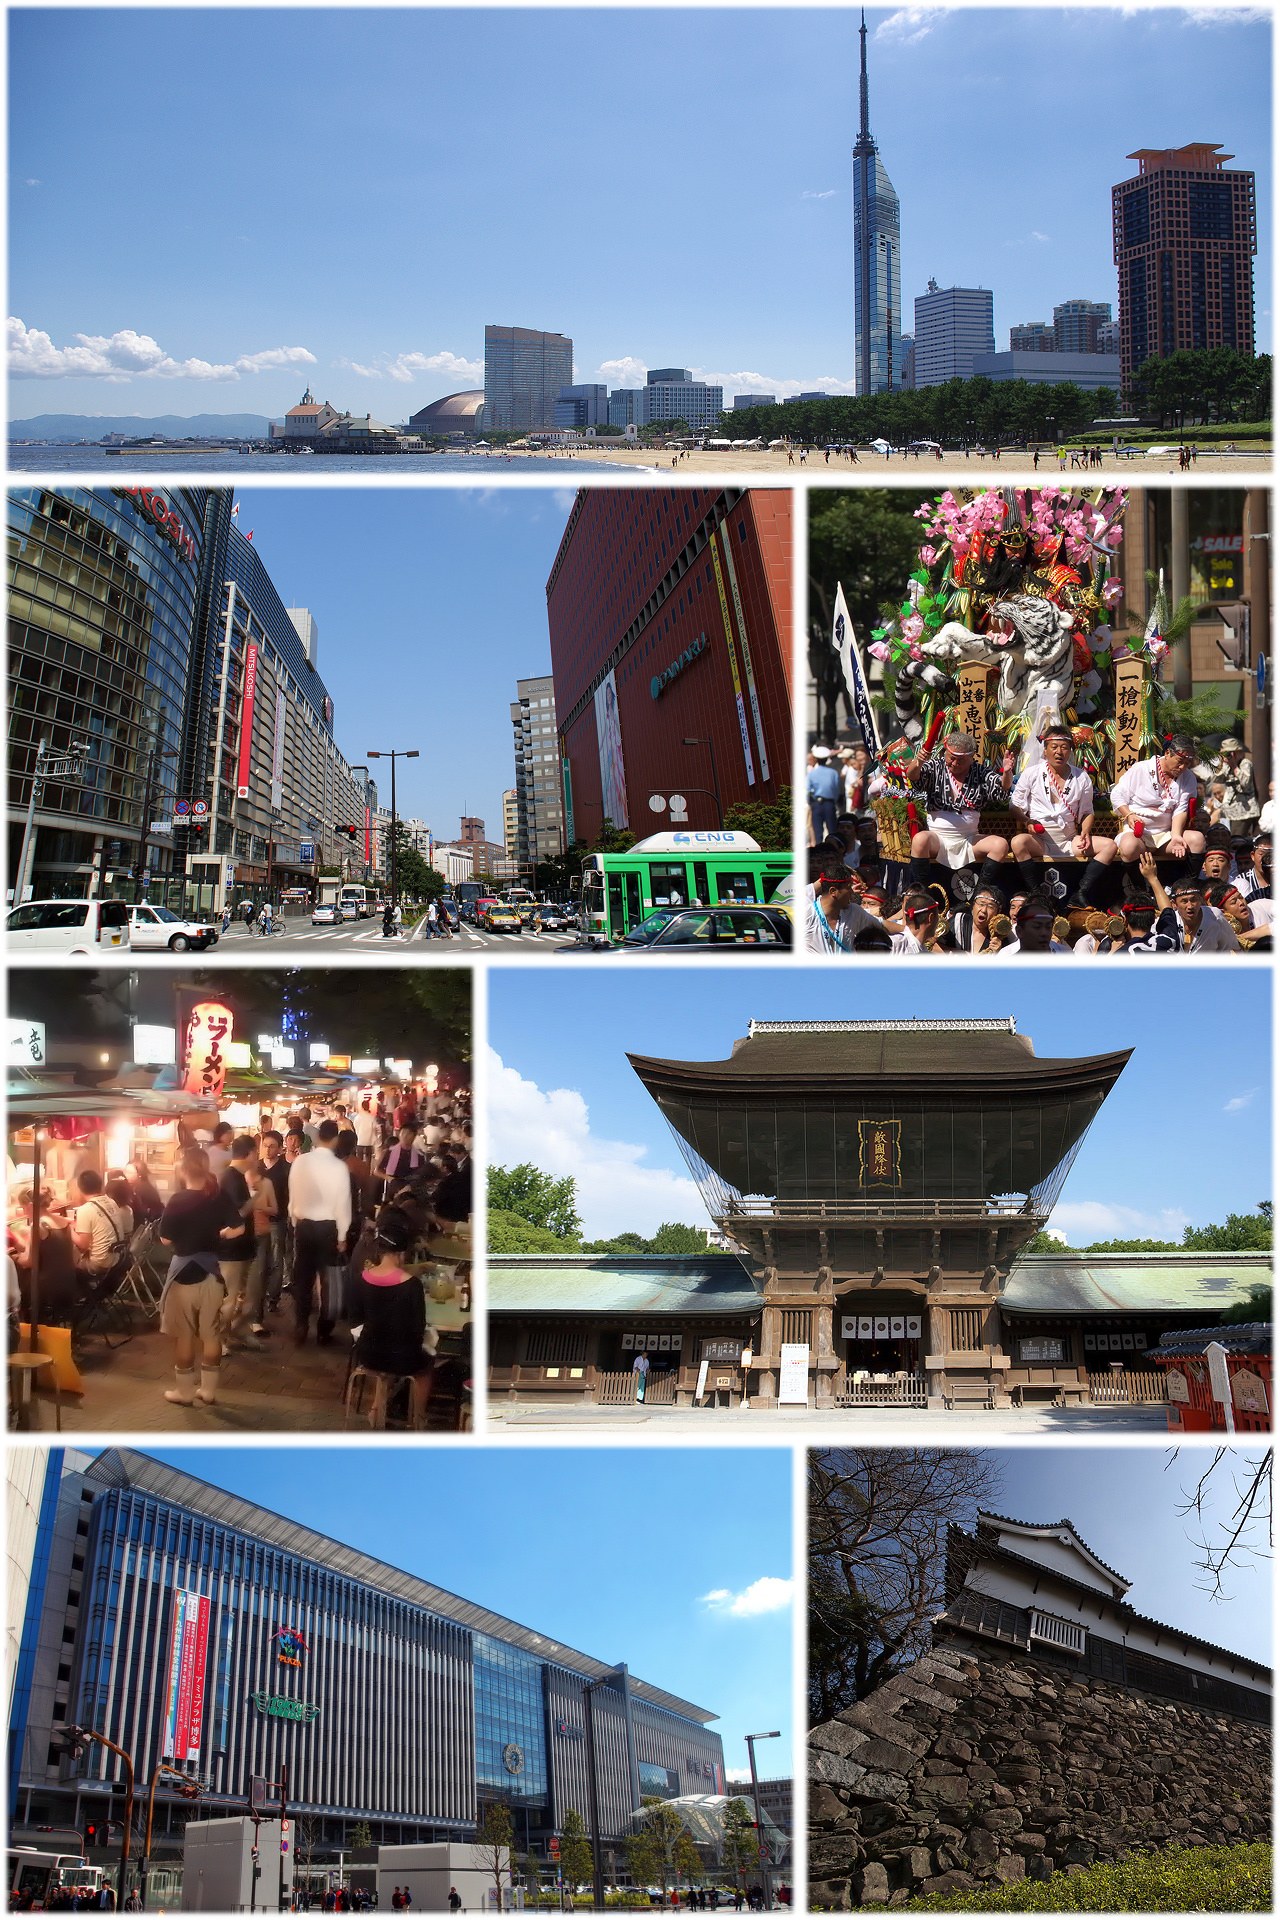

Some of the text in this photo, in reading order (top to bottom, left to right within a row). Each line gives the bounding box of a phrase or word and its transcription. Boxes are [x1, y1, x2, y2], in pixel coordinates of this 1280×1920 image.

[1204, 536, 1243, 552] SALE
[245, 648, 256, 699] MITSUKOSHI
[961, 677, 974, 703] 山笠
[1117, 674, 1141, 773] 一槍動天地
[695, 832, 735, 842] CNG
[190, 1675, 203, 1746] アミュプラザ博多
